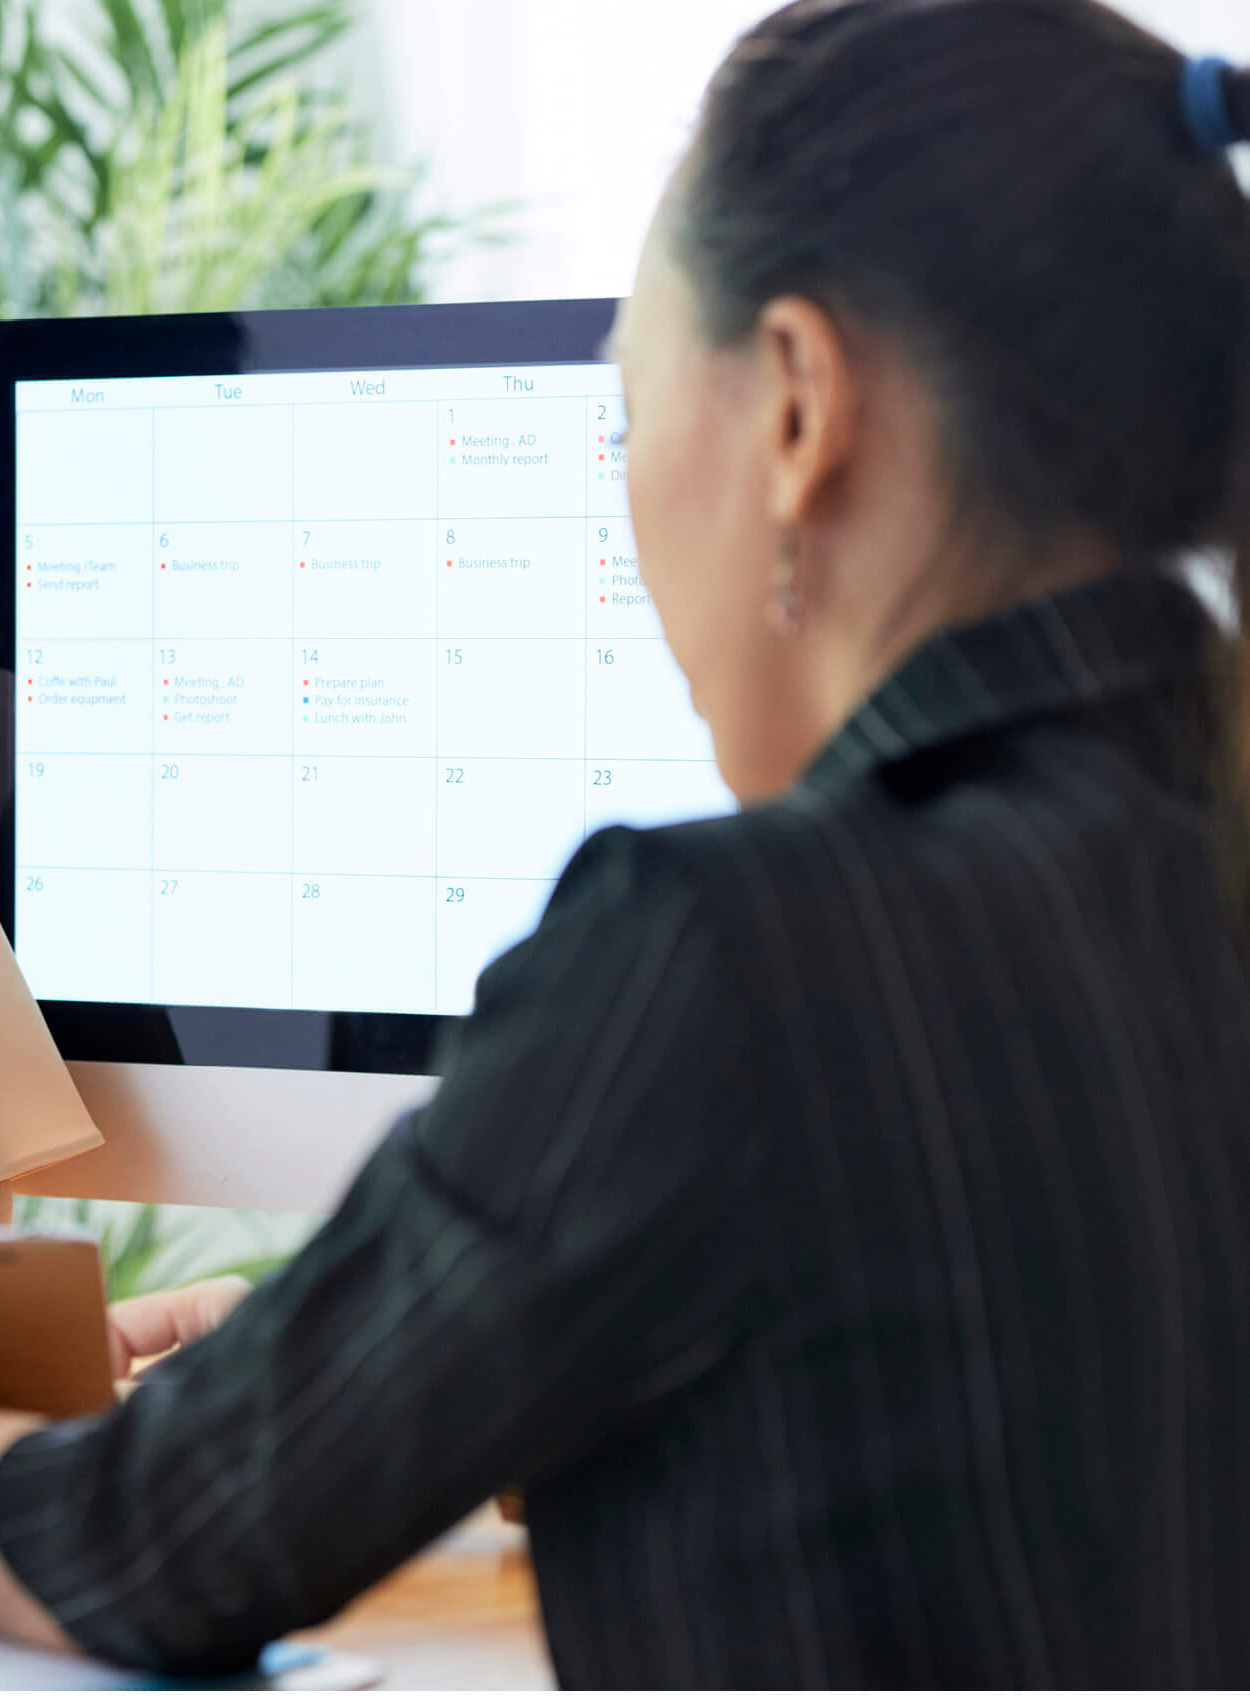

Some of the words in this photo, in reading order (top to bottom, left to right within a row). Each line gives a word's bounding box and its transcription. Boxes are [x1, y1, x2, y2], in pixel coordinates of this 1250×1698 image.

[350, 378, 386, 396] Wed
[502, 375, 535, 392] Thu
[70, 388, 105, 404] Mon
[214, 384, 243, 400] Tue
[448, 408, 454, 424] 1
[598, 404, 607, 420] 2
[462, 435, 509, 448] Meeting
[518, 434, 536, 446] AD
[462, 454, 509, 467] Monthly
[512, 454, 549, 468] report
[25, 534, 34, 550] 5
[159, 533, 169, 549] 6
[302, 530, 310, 545] 7
[446, 529, 455, 545] 8
[598, 528, 608, 543] 9
[37, 561, 80, 574] Meeting
[171, 559, 217, 571] Business
[220, 559, 240, 573] trip
[311, 558, 358, 570] Business
[361, 558, 381, 571] trip
[458, 556, 507, 568] Business
[510, 556, 531, 571] trip
[37, 579, 63, 590] Send
[66, 579, 99, 592] report
[27, 648, 44, 664] 12
[160, 649, 176, 664] 13
[302, 648, 318, 664] 14
[445, 648, 463, 664] 15
[597, 648, 614, 664] 16
[69, 676, 91, 687] with
[94, 675, 116, 687] Paul
[174, 676, 219, 689] Meeting
[227, 676, 244, 688] AD
[315, 676, 357, 690] Prepare
[360, 675, 385, 690] plan
[37, 693, 68, 704] Order
[174, 693, 237, 704] Photoshoot
[315, 694, 334, 708] Pay
[337, 694, 351, 704] for
[354, 695, 409, 706] insurance
[174, 711, 192, 722] Get
[196, 711, 230, 724] report
[315, 711, 349, 723] Lunch
[351, 711, 376, 723] with
[380, 711, 406, 724] John
[28, 762, 45, 777] 19
[161, 763, 179, 779] 20
[301, 766, 318, 781] 21
[445, 768, 463, 784] 22
[592, 770, 612, 786] 23
[25, 876, 43, 891] 26
[159, 880, 177, 895] 27
[301, 882, 320, 899] 28
[445, 887, 465, 903] 29
